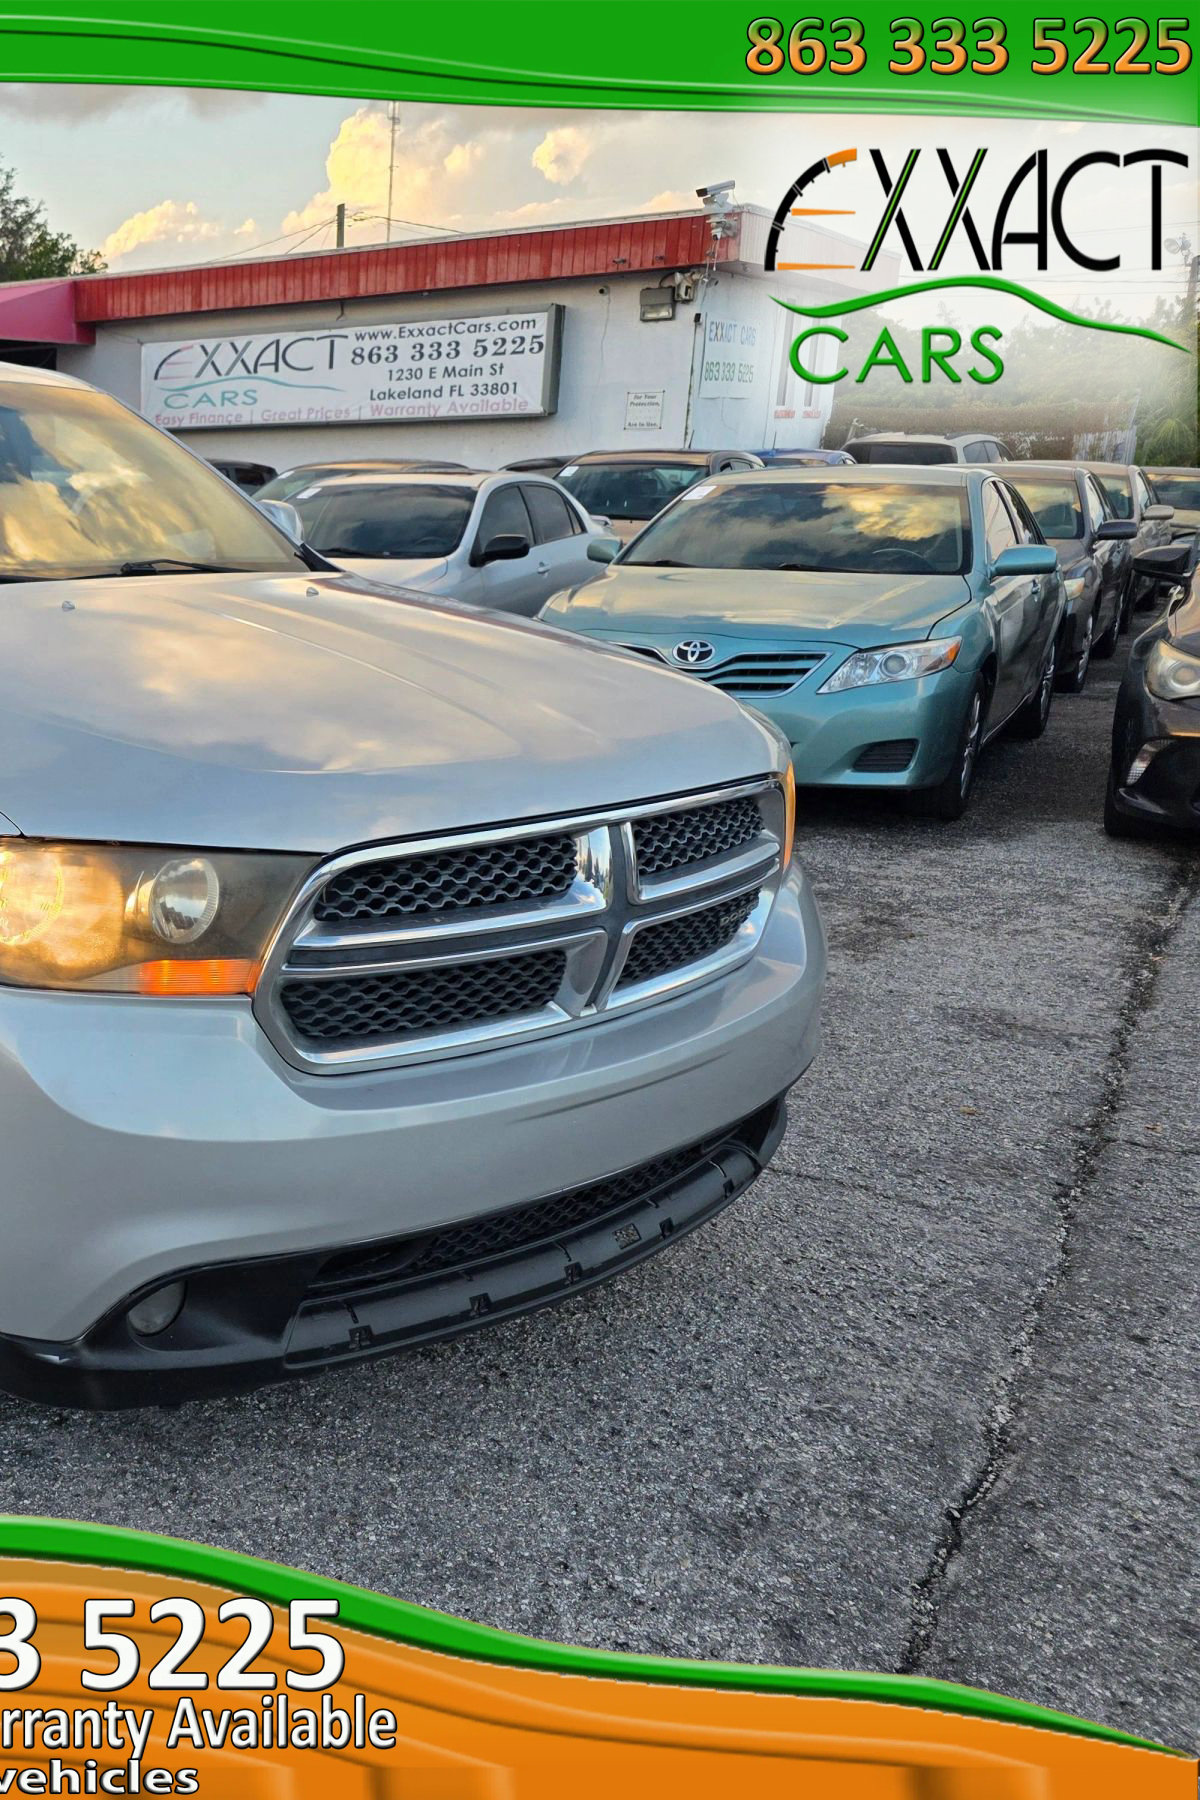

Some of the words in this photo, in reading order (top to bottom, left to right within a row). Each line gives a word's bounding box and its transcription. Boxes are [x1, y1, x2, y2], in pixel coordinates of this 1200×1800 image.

[355, 318, 537, 341] www.ExxactCars.com
[154, 335, 349, 380] EXXACT
[351, 344, 399, 366] 863
[411, 340, 461, 362] 333
[472, 334, 545, 358] 5225
[387, 367, 423, 381] 1230
[429, 366, 437, 379] E
[442, 364, 483, 378] Main
[489, 362, 504, 376] St
[163, 390, 258, 409] CARS
[370, 385, 443, 400] Lakeland
[449, 384, 464, 397] FL
[470, 382, 518, 397] 33801
[155, 413, 184, 426] Easy
[189, 412, 243, 424] Finance
[261, 408, 302, 422] Great
[307, 407, 350, 420] Prices
[370, 402, 440, 418] Warranty
[447, 398, 529, 413] Available
